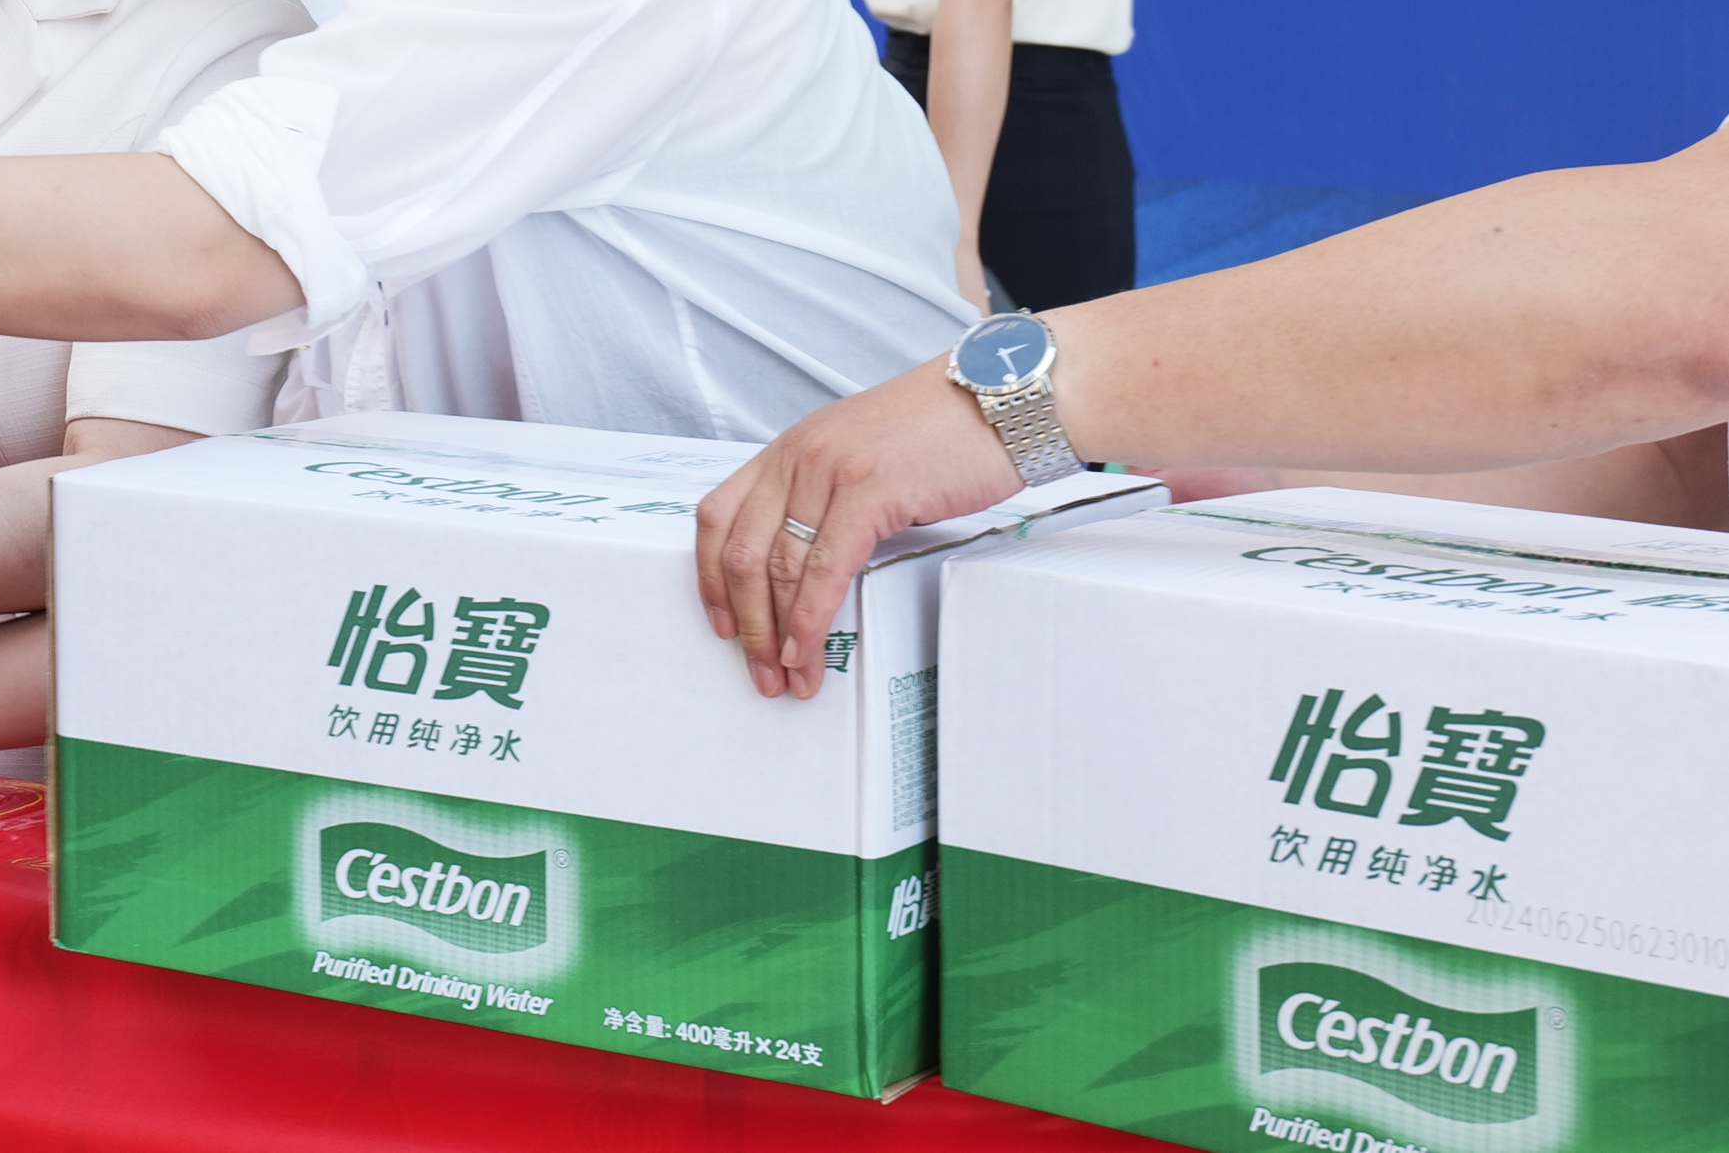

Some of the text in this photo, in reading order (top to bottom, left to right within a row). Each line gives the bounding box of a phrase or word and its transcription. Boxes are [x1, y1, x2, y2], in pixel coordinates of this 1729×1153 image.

[351, 489, 617, 525] 饮用纯净水
[1303, 579, 1628, 622] 饮用纯净水
[325, 583, 551, 711] 怡寶
[327, 703, 523, 763] 饮用纯净水
[1267, 687, 1547, 843] 怡寶
[1268, 823, 1510, 904] 饮用纯净水
[311, 950, 555, 1016] Purified Drinking Water
[1248, 1106, 1353, 1153] Purified
